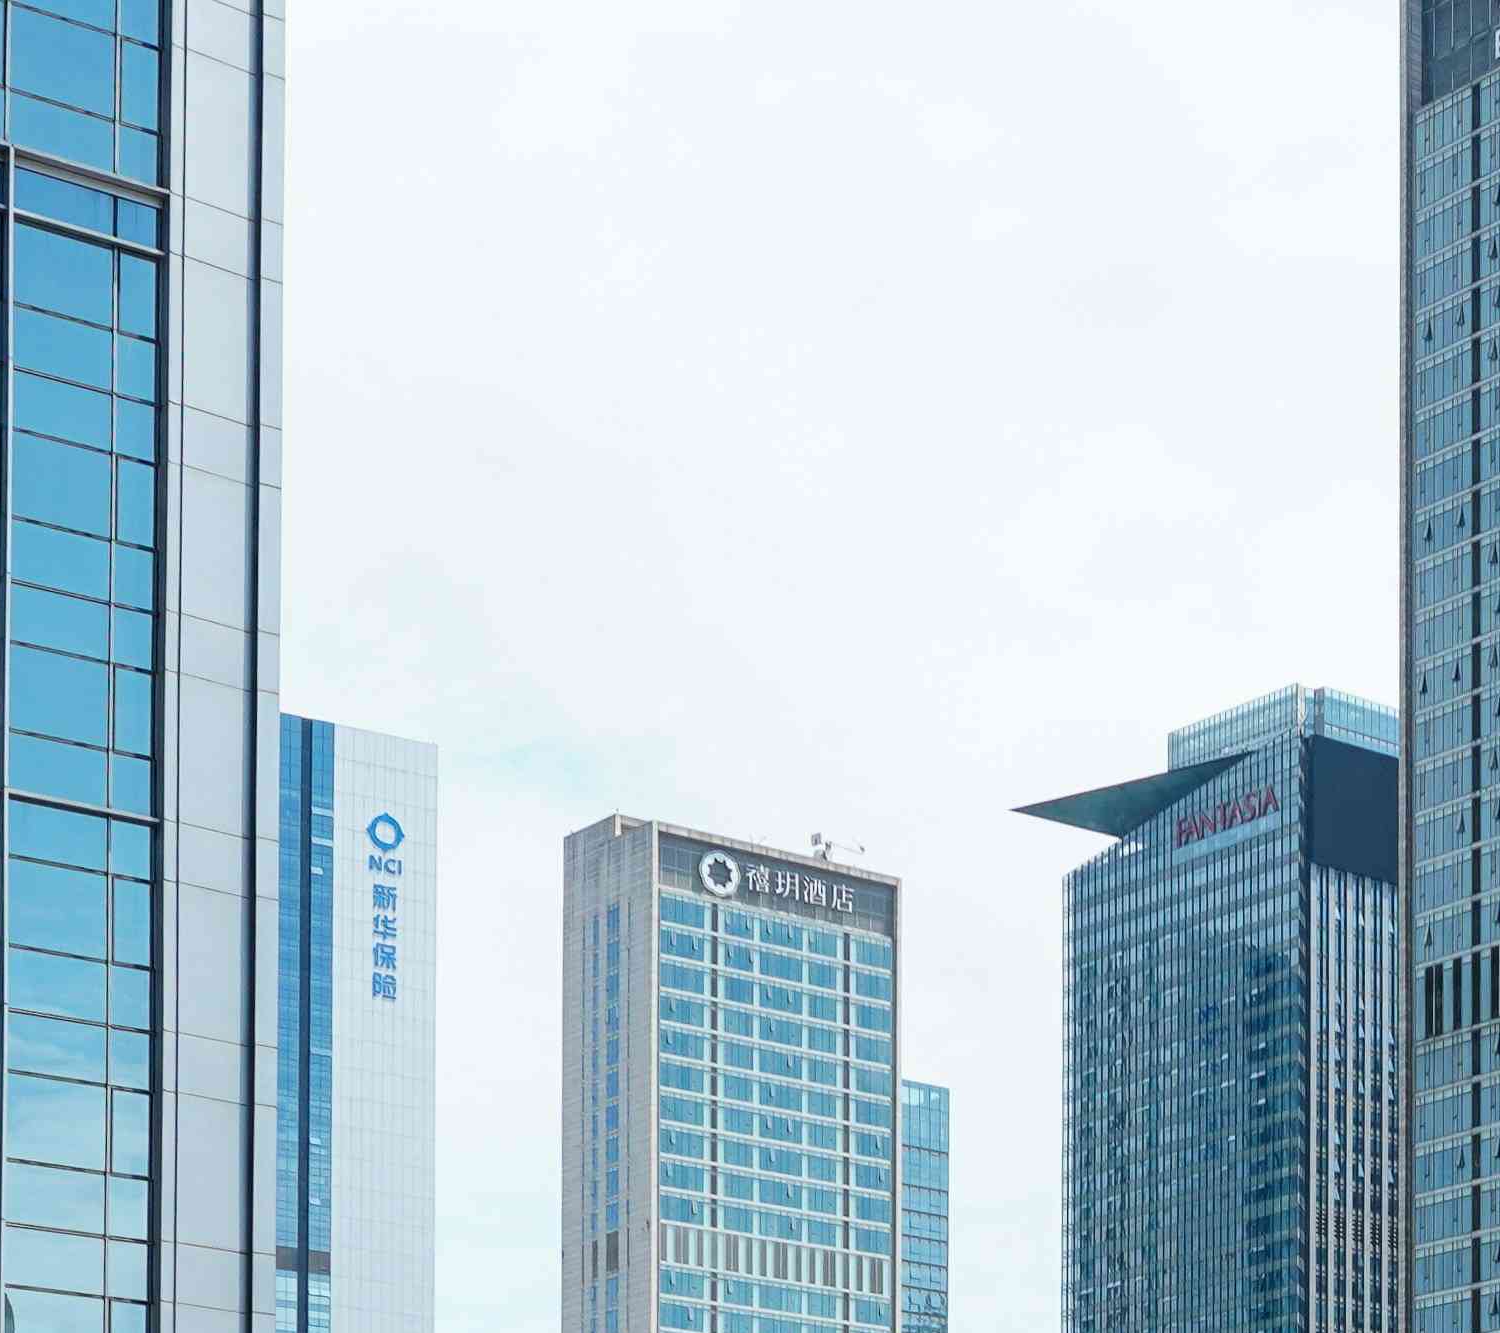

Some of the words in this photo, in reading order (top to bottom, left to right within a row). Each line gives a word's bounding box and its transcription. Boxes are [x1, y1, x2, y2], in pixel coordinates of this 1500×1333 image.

[1175, 785, 1280, 848] FANTASIA
[368, 855, 402, 876] NCI
[746, 864, 855, 913] 禧玥酒店
[372, 883, 397, 1001] 新华保险
